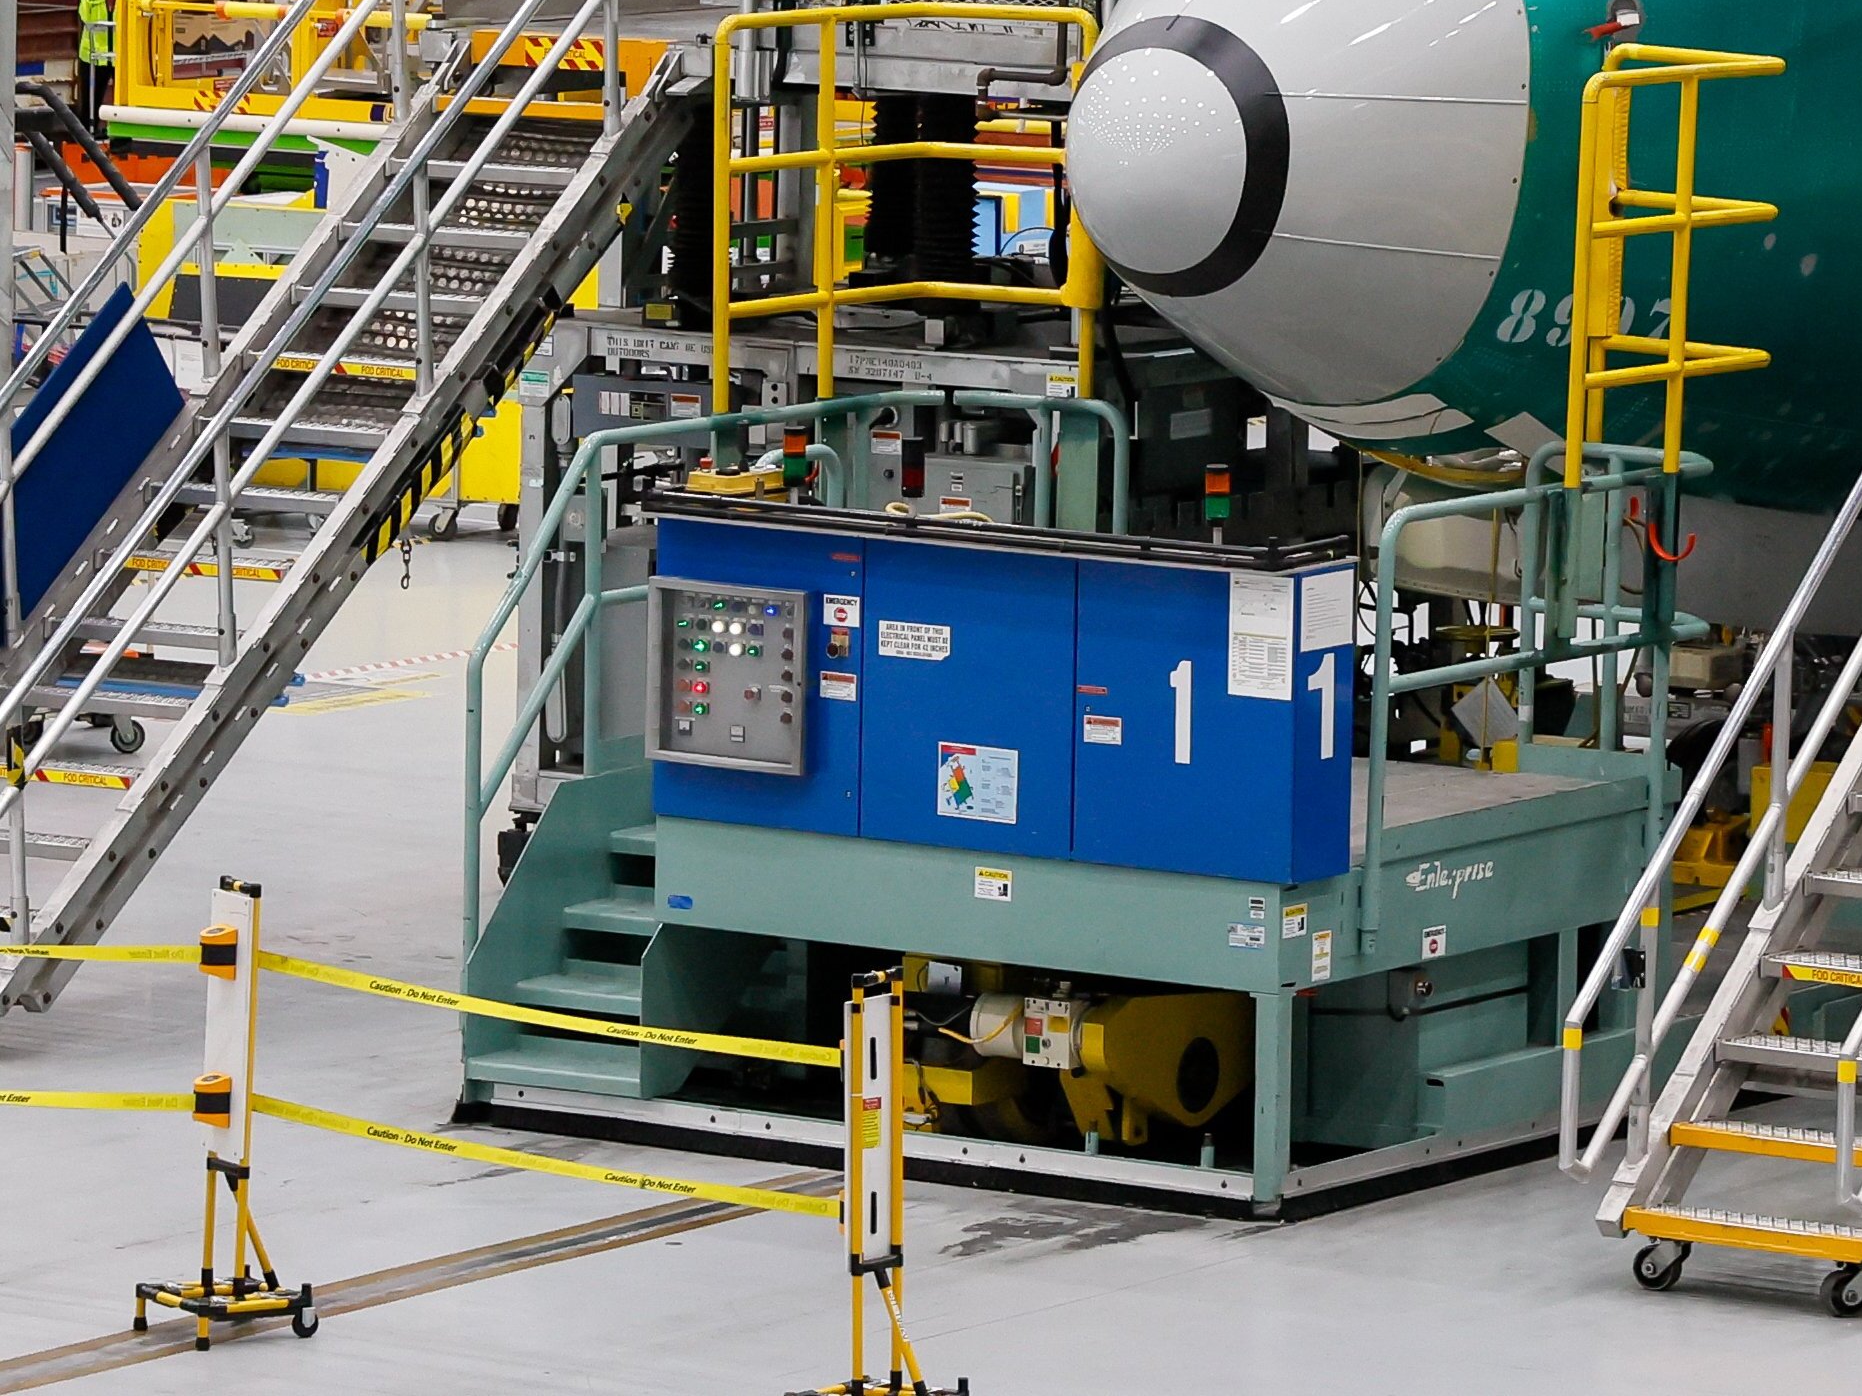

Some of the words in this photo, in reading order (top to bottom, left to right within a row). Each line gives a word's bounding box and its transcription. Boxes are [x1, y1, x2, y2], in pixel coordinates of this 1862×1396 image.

[276, 358, 289, 368] FOD
[290, 359, 317, 370] CRITICA
[361, 366, 374, 375] FOD
[376, 367, 404, 378] CRITICAL
[132, 558, 146, 567] FOD
[825, 597, 858, 606] EMERGENCY
[1170, 660, 1192, 764] 1
[1308, 653, 1335, 760] 1
[78, 773, 107, 785] CRITICAL
[1812, 969, 1828, 981] FOD
[369, 980, 402, 995] Caution
[406, 988, 420, 998] Do
[420, 991, 436, 1002] Not
[436, 994, 460, 1006] Enter
[606, 1025, 639, 1037] Caution
[644, 1031, 658, 1040] Do
[658, 1032, 674, 1042] Not
[674, 1035, 698, 1045] Enter
[6, 1093, 31, 1103] Enter
[367, 1126, 399, 1140] Caution
[404, 1134, 417, 1145] Do
[418, 1137, 433, 1148] Not
[434, 1140, 458, 1152] Enter
[604, 1172, 637, 1185] Caution
[643, 1178, 656, 1188] Do
[656, 1179, 672, 1190] Not
[673, 1182, 697, 1194] Enter
